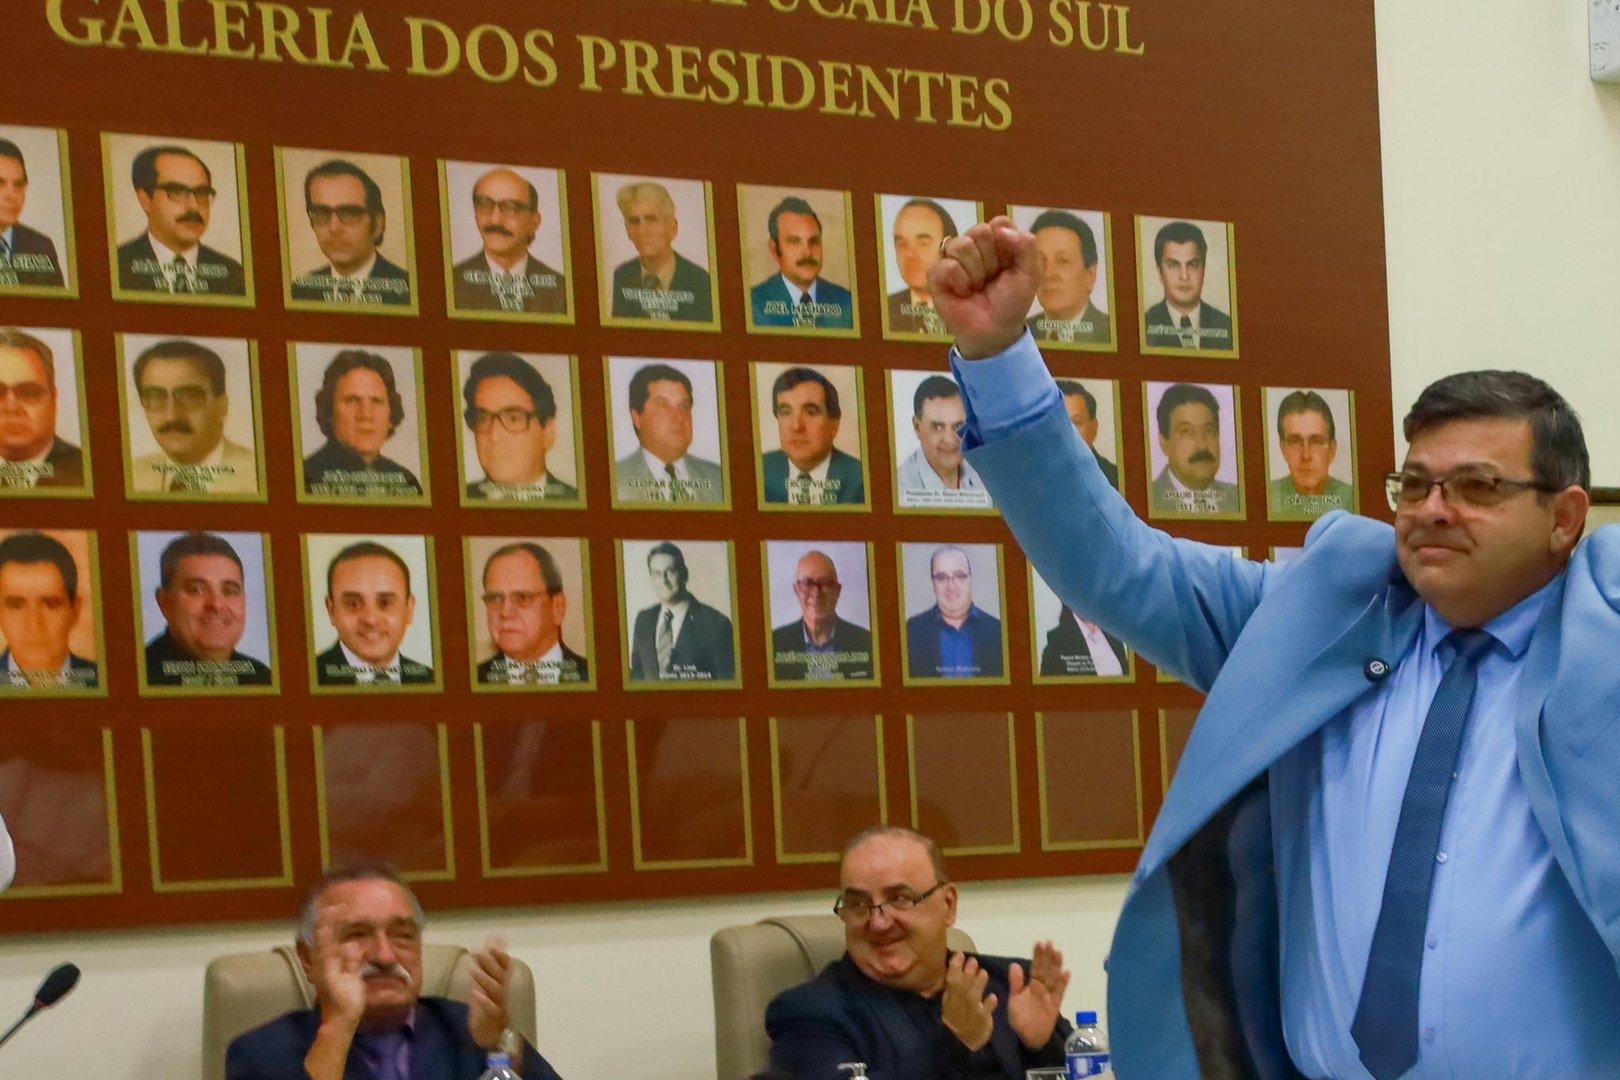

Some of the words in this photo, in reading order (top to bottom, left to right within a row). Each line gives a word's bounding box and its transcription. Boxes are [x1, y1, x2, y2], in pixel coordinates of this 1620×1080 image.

[951, 0, 1034, 40] DO
[1047, 0, 1146, 54] SUL
[45, 0, 389, 72] GALERIA
[405, 16, 558, 87] DOS
[576, 34, 1013, 131] PRESIDENTES
[763, 300, 789, 315] JOEL
